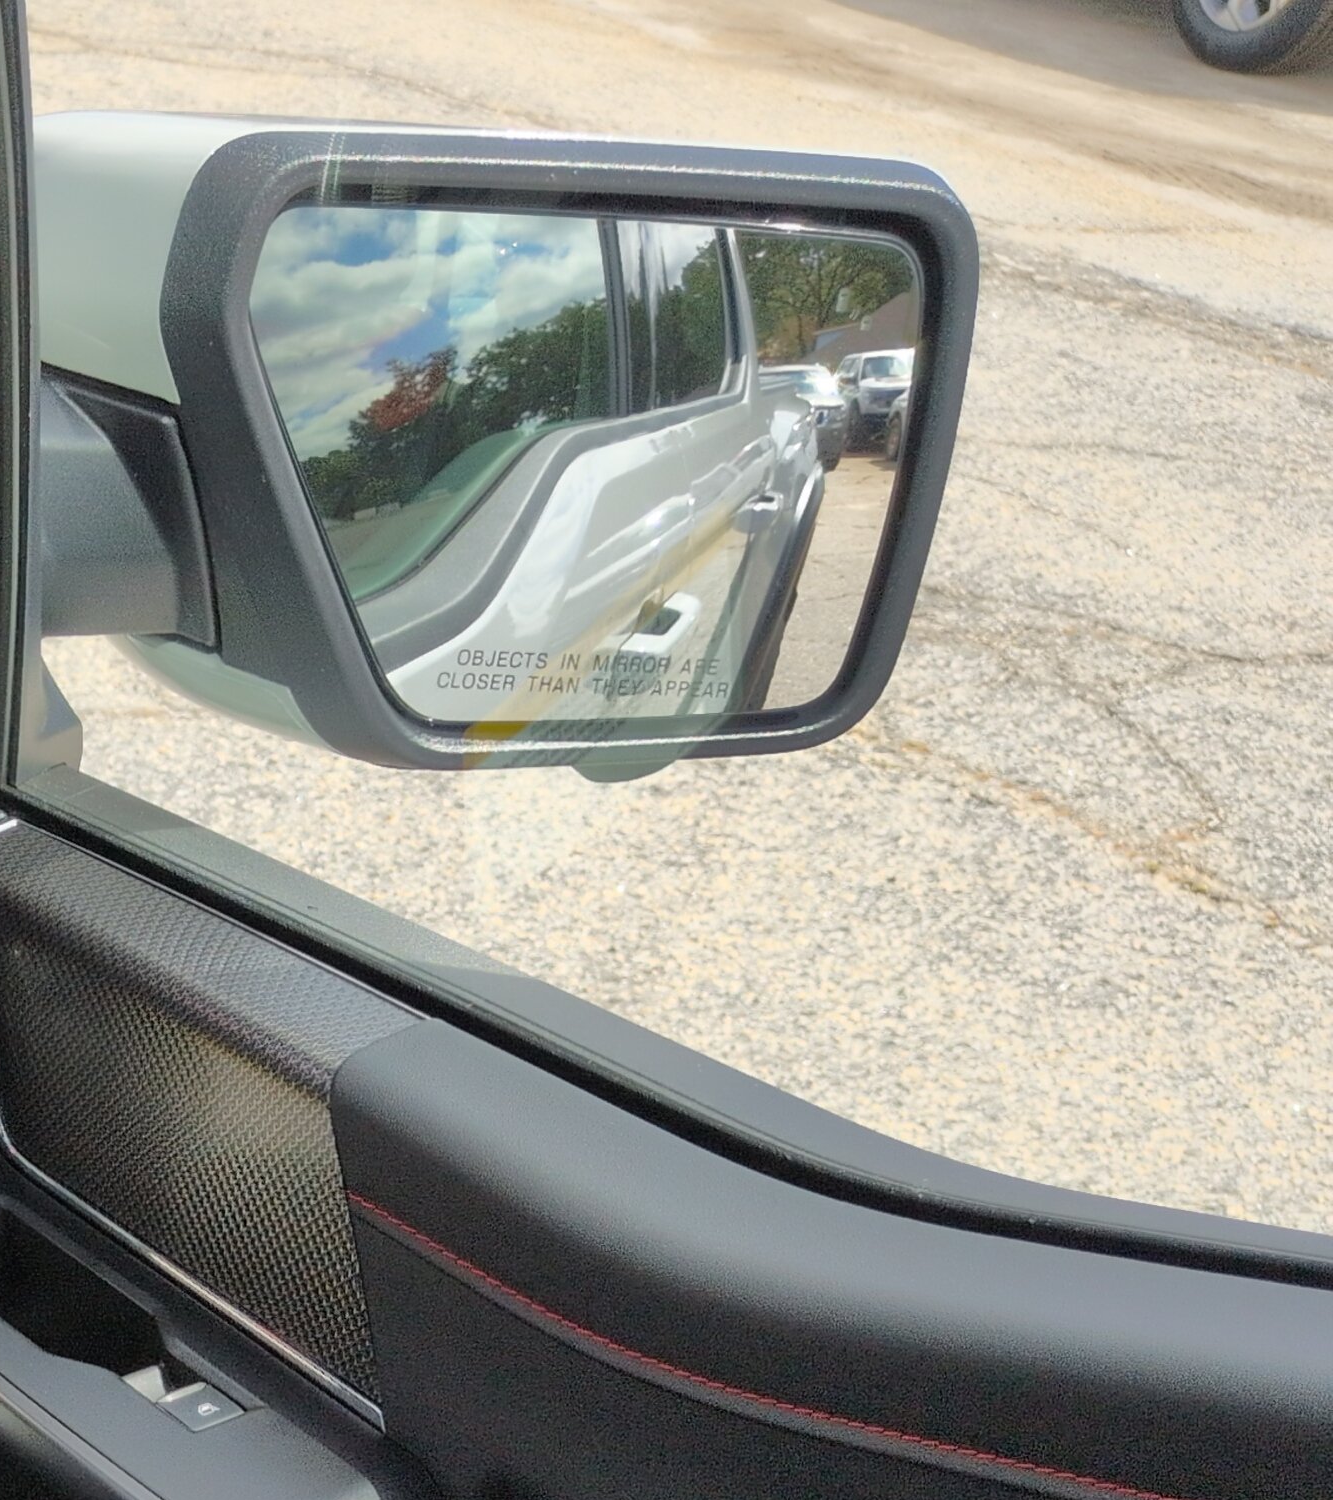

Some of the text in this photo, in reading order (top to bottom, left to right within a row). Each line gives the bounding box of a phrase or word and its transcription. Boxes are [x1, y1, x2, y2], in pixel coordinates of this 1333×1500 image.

[457, 649, 721, 675] OBJECTS IN MIRROR ARE
[437, 672, 729, 698] CLOSER THAN THEY APPEAR
